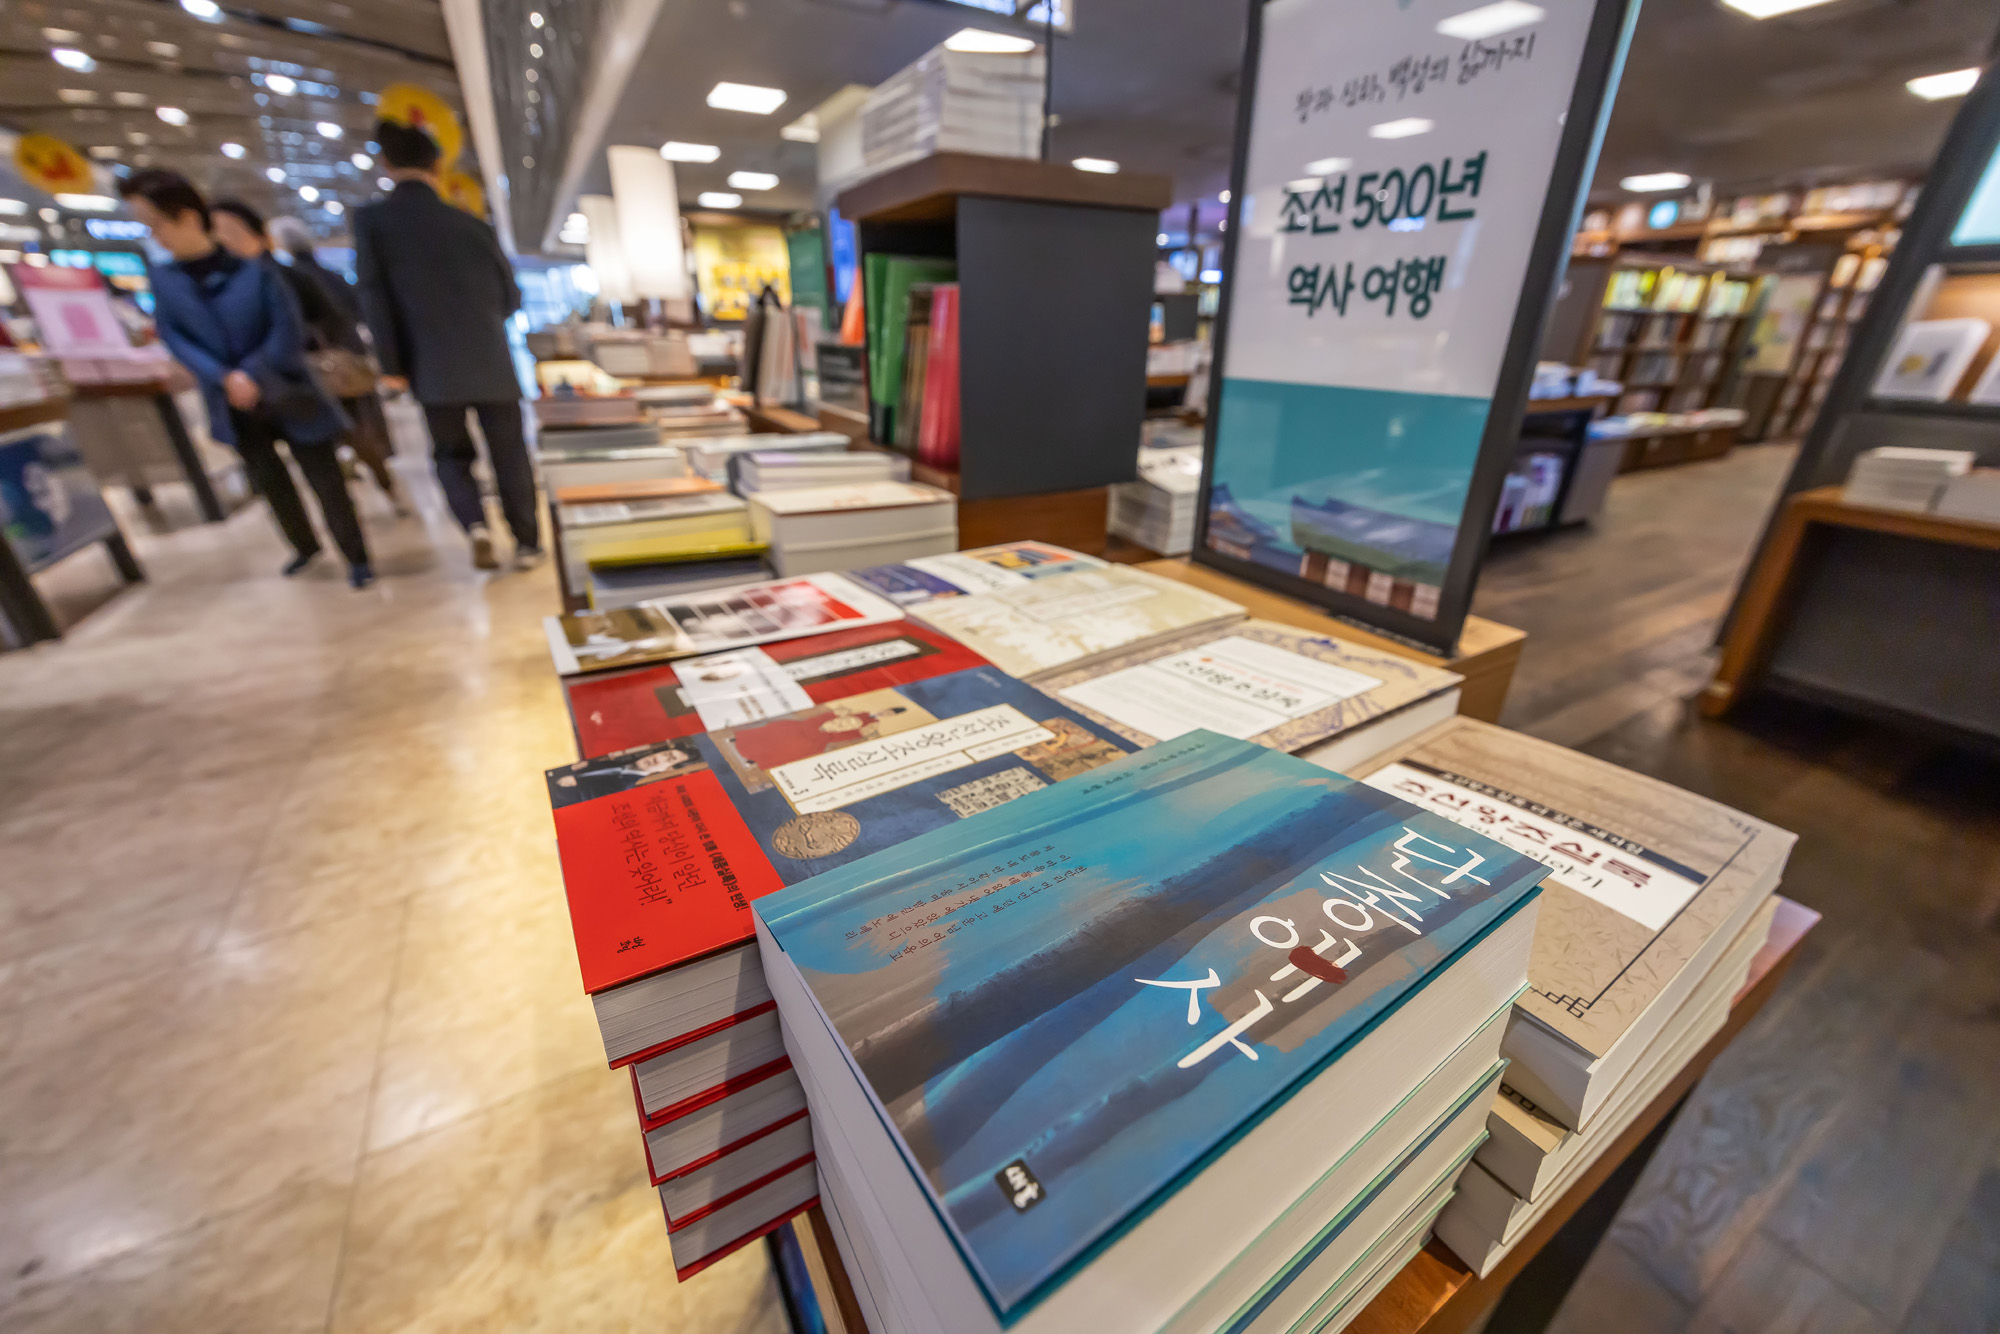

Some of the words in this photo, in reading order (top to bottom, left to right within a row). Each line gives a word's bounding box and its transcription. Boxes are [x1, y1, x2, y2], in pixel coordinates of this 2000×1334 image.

[1388, 55, 1450, 99] 백성의
[1457, 32, 1535, 85] 삶까지
[1278, 174, 1347, 235] 조선
[1352, 150, 1488, 229] 500년
[1288, 261, 1356, 318] 역사
[1362, 256, 1447, 320] 여행
[620, 829, 649, 864] 역사는
[658, 830, 694, 865] 당신이
[1393, 778, 1651, 888] 조선왕조실록
[673, 863, 706, 891] 알던
[730, 892, 749, 911] 탄생!
[1134, 826, 1491, 1068] 단종애사
